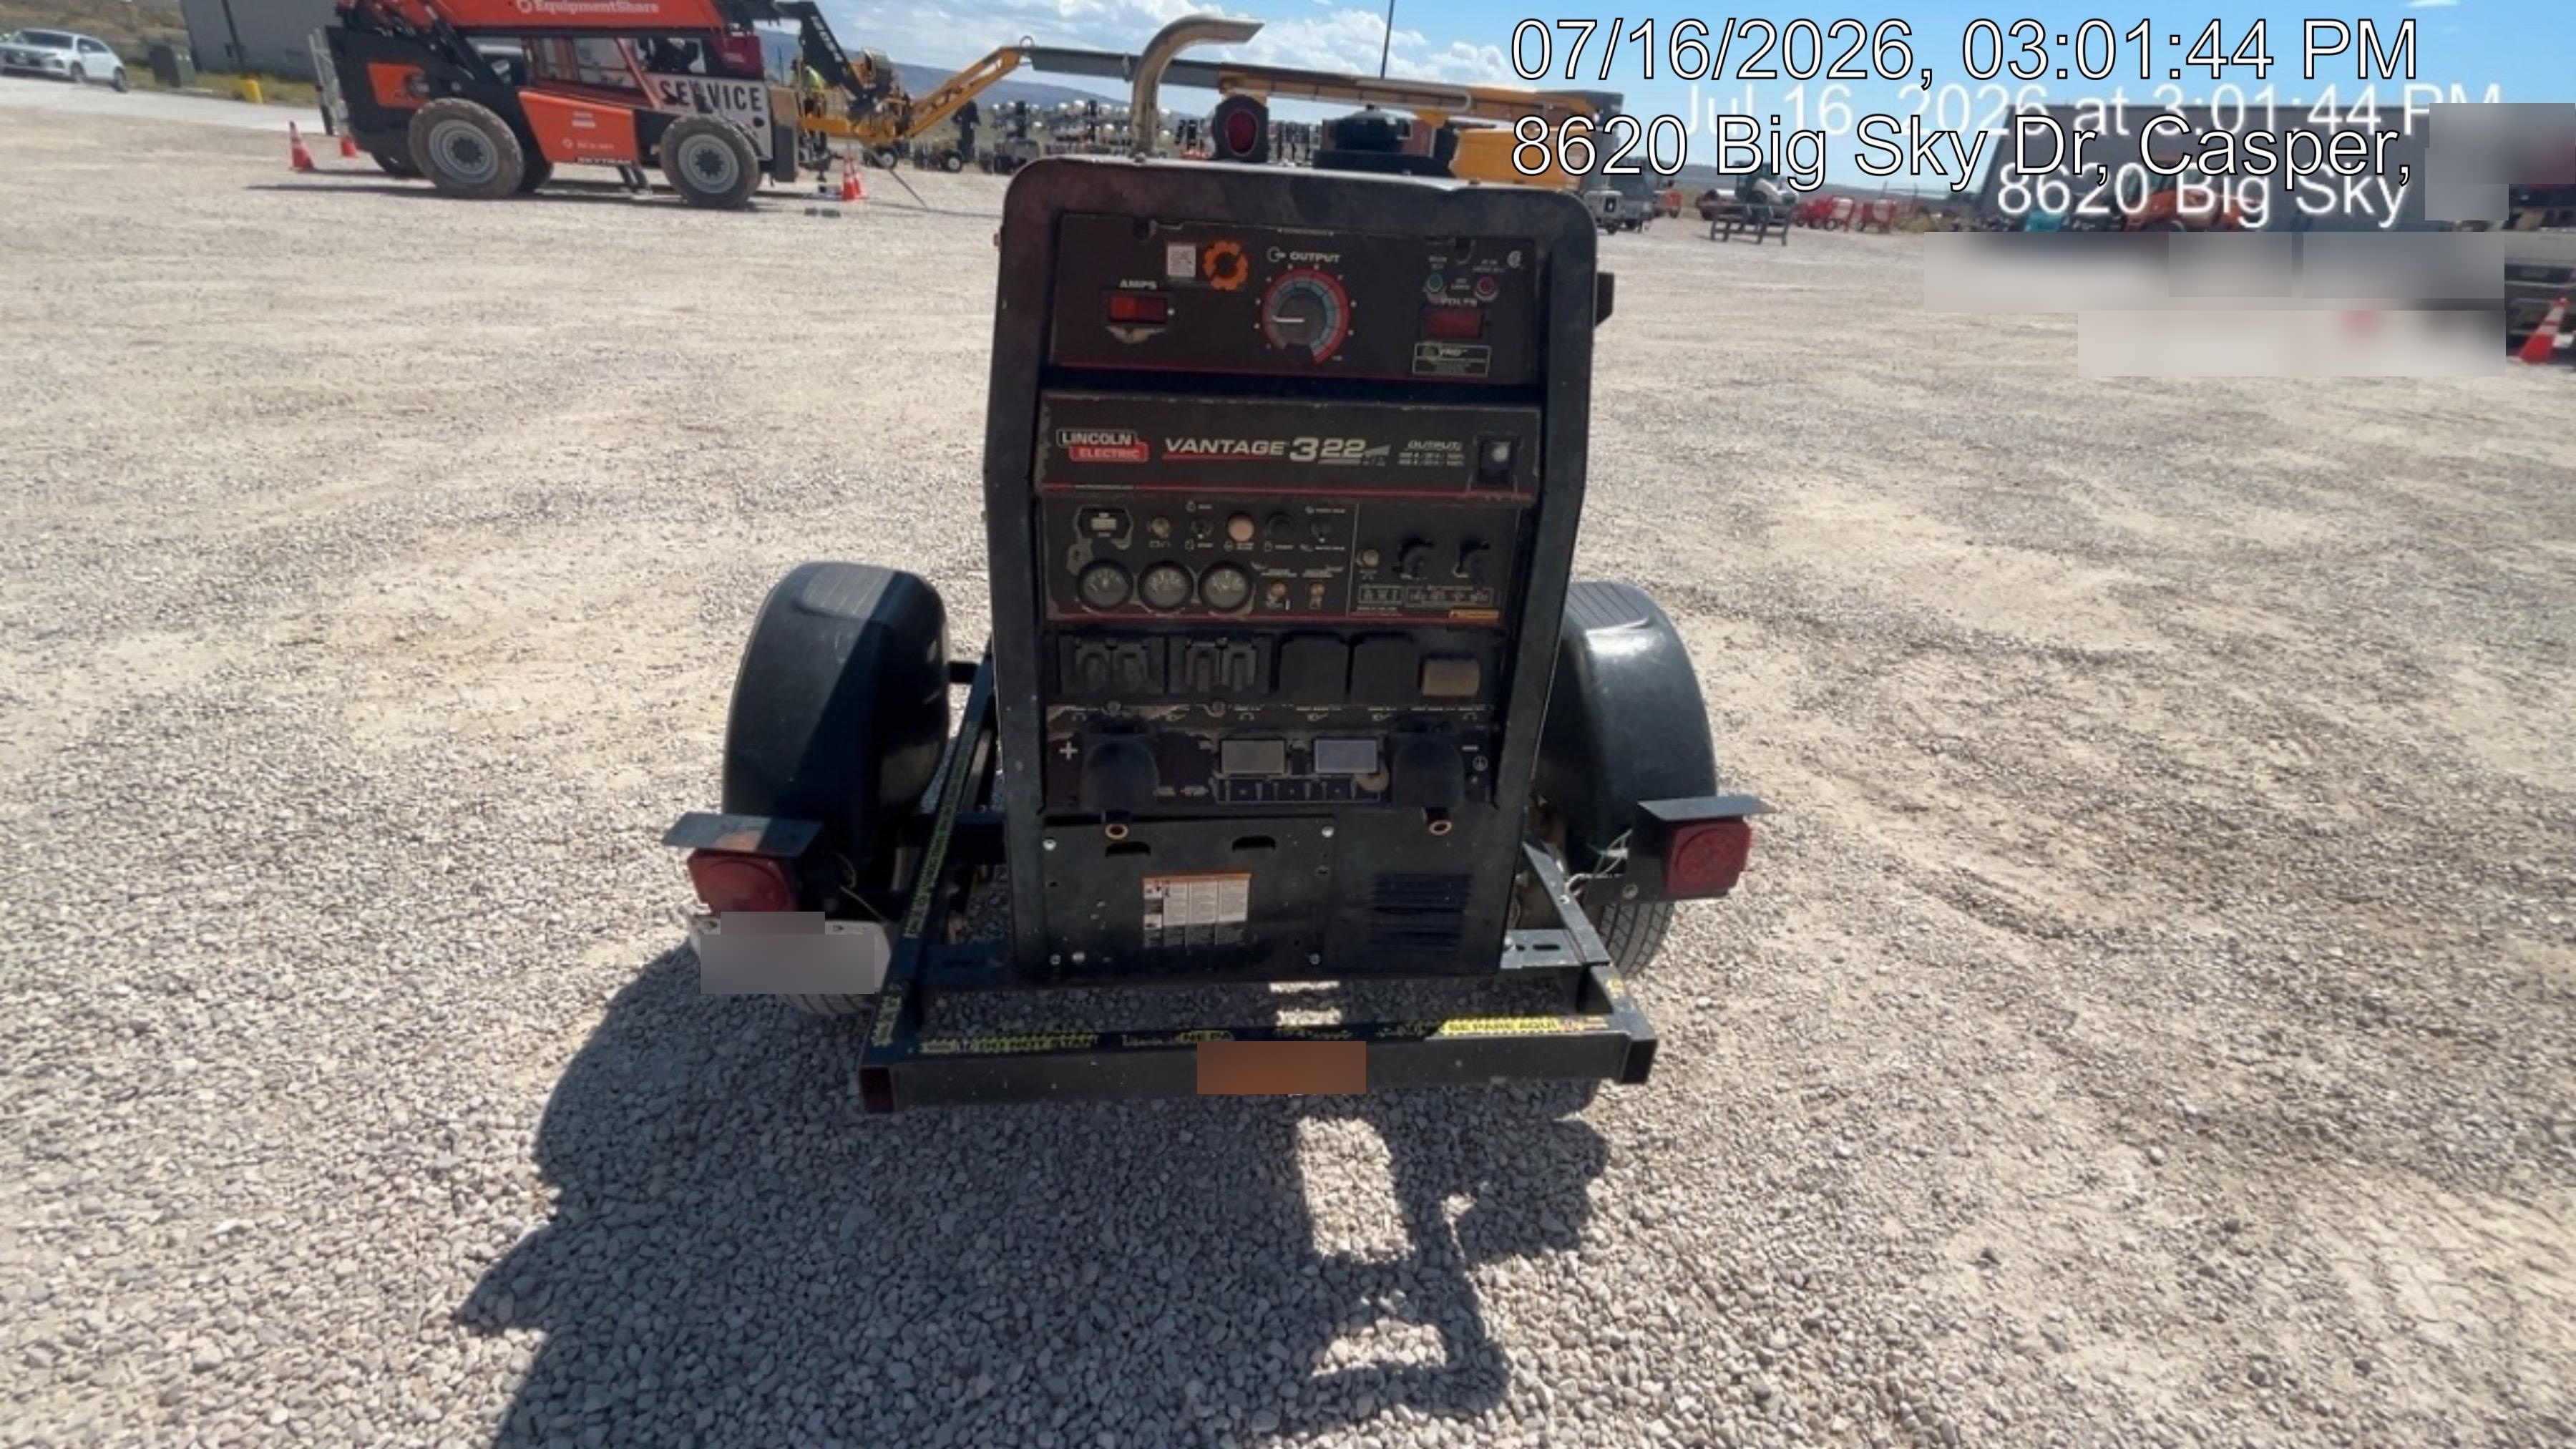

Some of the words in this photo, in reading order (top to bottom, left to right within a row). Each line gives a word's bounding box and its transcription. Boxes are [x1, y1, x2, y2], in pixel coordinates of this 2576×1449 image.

[1289, 251, 1340, 263] OUTPUT
[1062, 431, 1133, 445] LINCOLN
[1079, 447, 1140, 459] ELECTRIC
[1165, 438, 1286, 456] VANTAGE
[1289, 437, 1367, 462] 322
